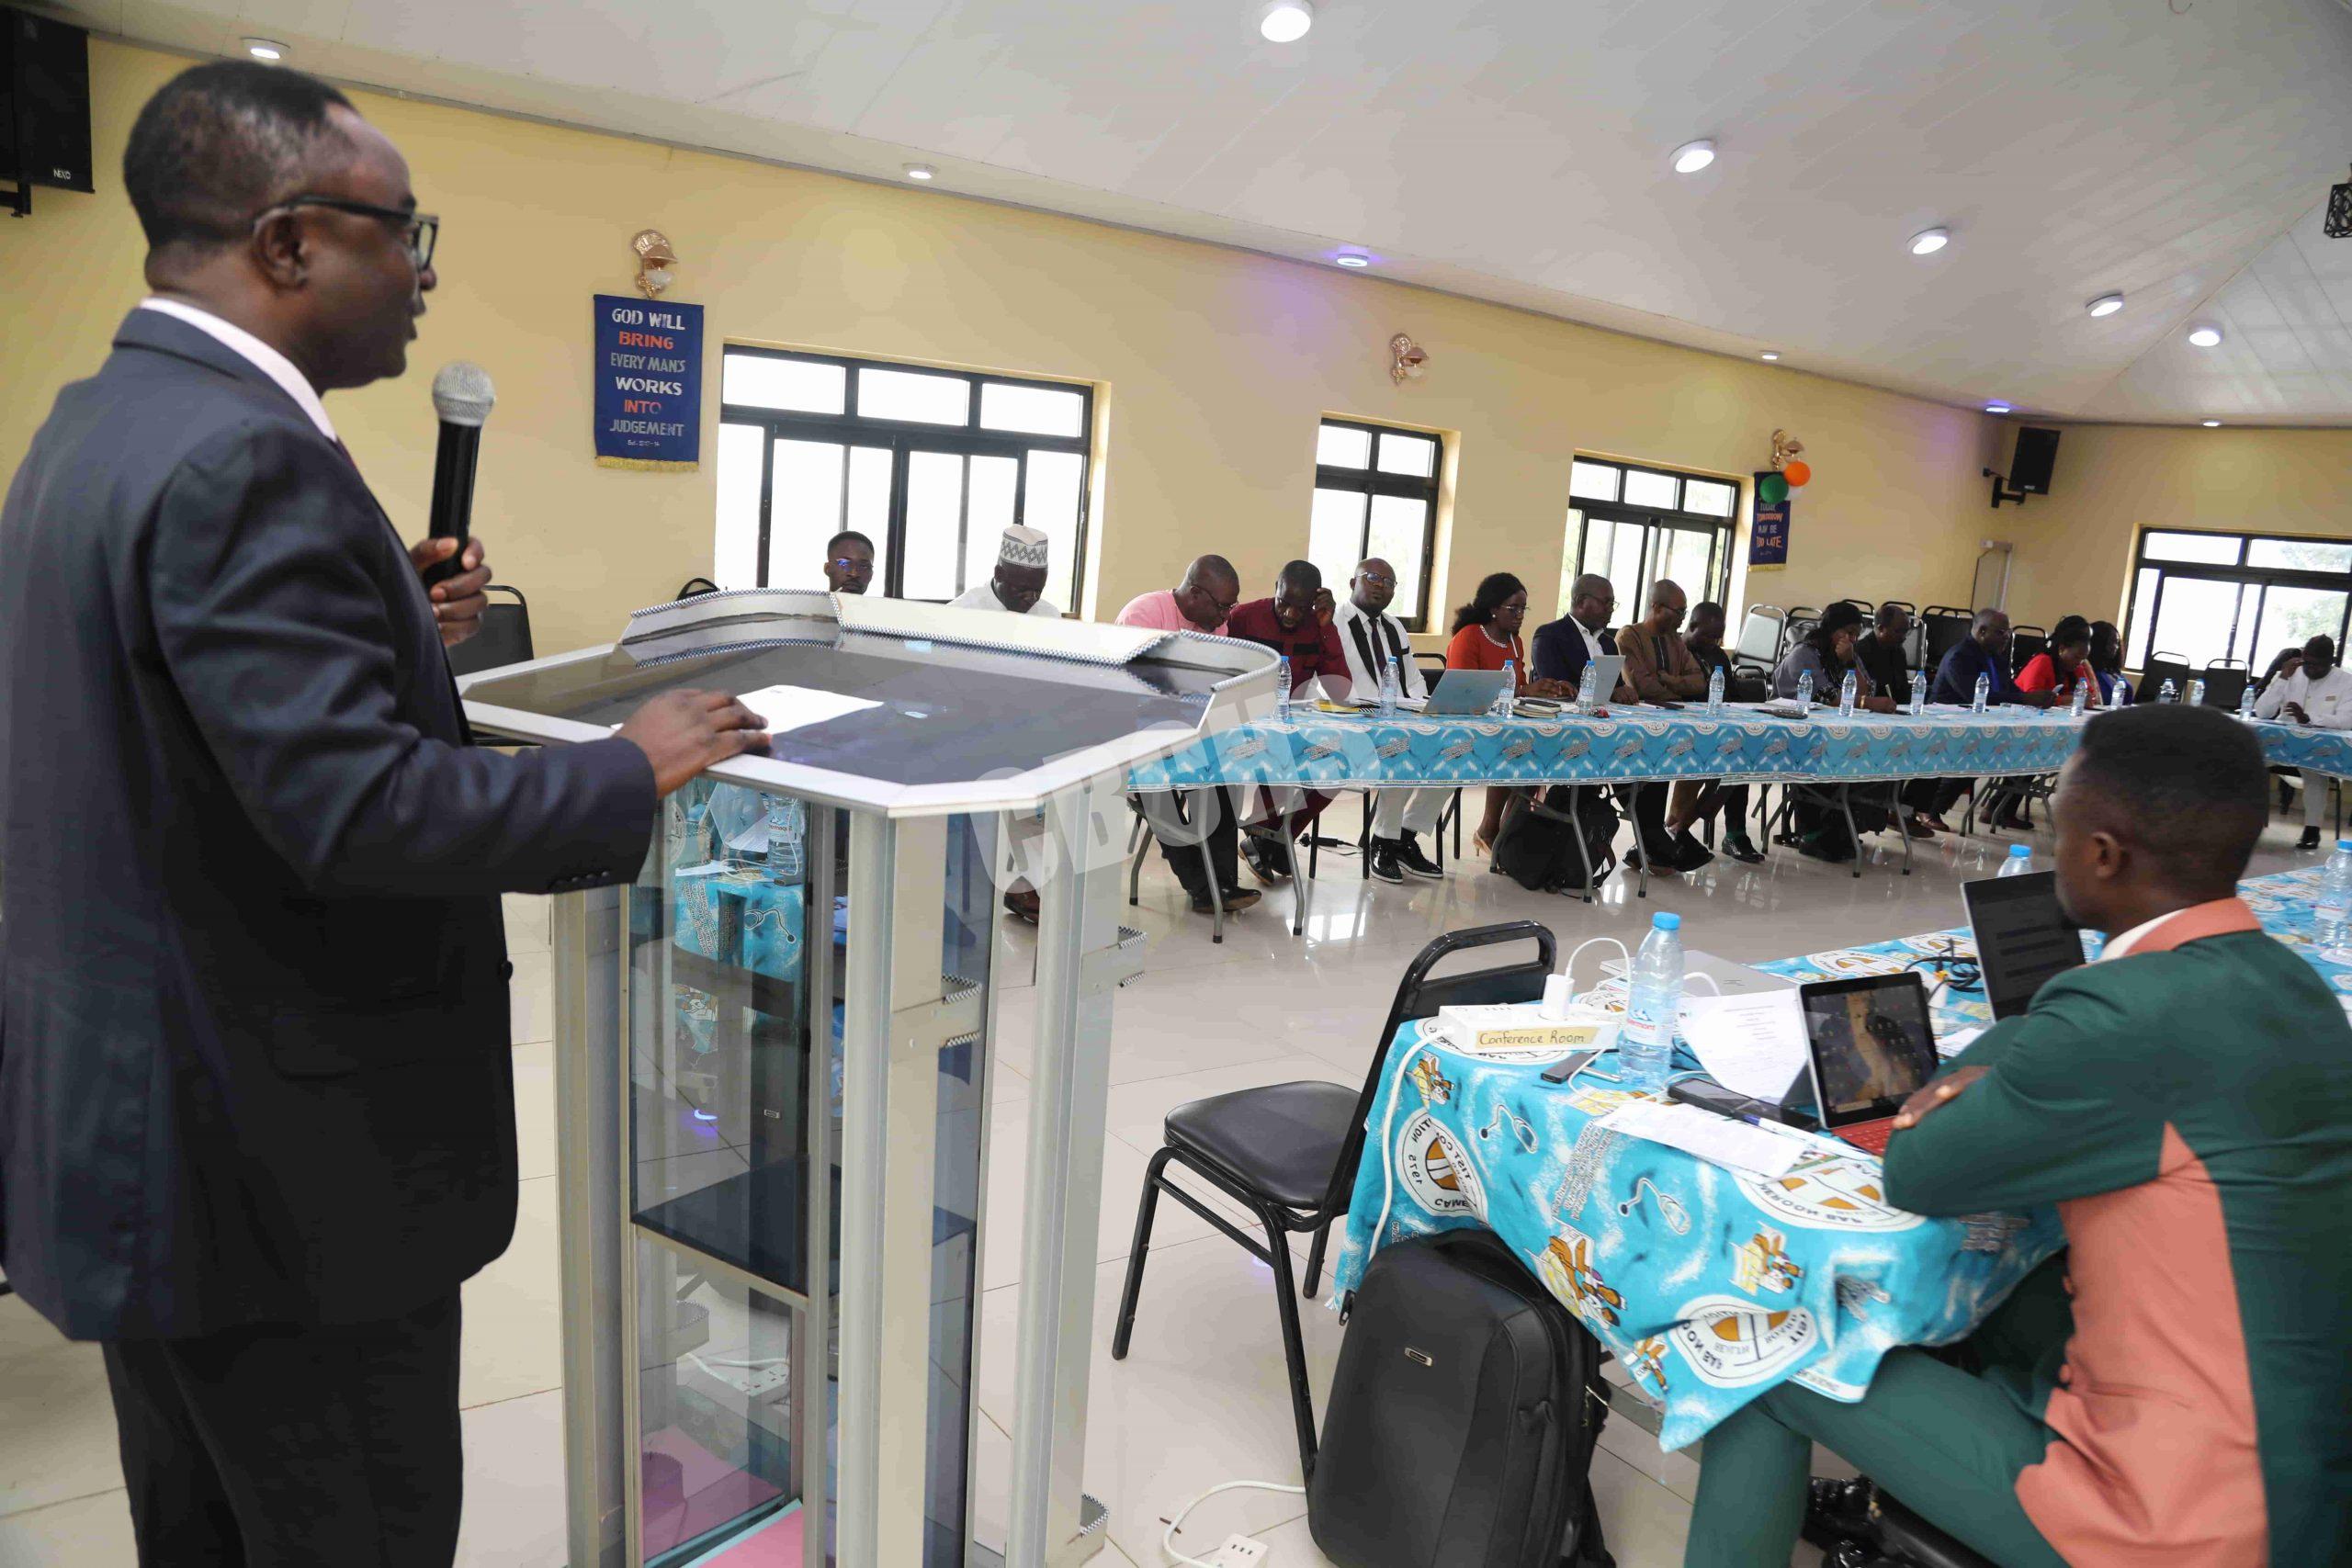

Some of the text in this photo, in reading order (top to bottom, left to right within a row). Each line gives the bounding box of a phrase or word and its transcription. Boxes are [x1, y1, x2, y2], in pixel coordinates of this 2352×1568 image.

[53, 168, 72, 180] NEXO
[612, 308, 685, 331] GOD WILL
[618, 331, 674, 350] BRING
[610, 352, 646, 369] EVERY
[615, 376, 683, 396] WORKS
[624, 400, 662, 414] INTO
[609, 419, 684, 437] JUDGEMENT
[1766, 536, 1783, 548] LATE
[1479, 1030, 1585, 1045] Conference Room
